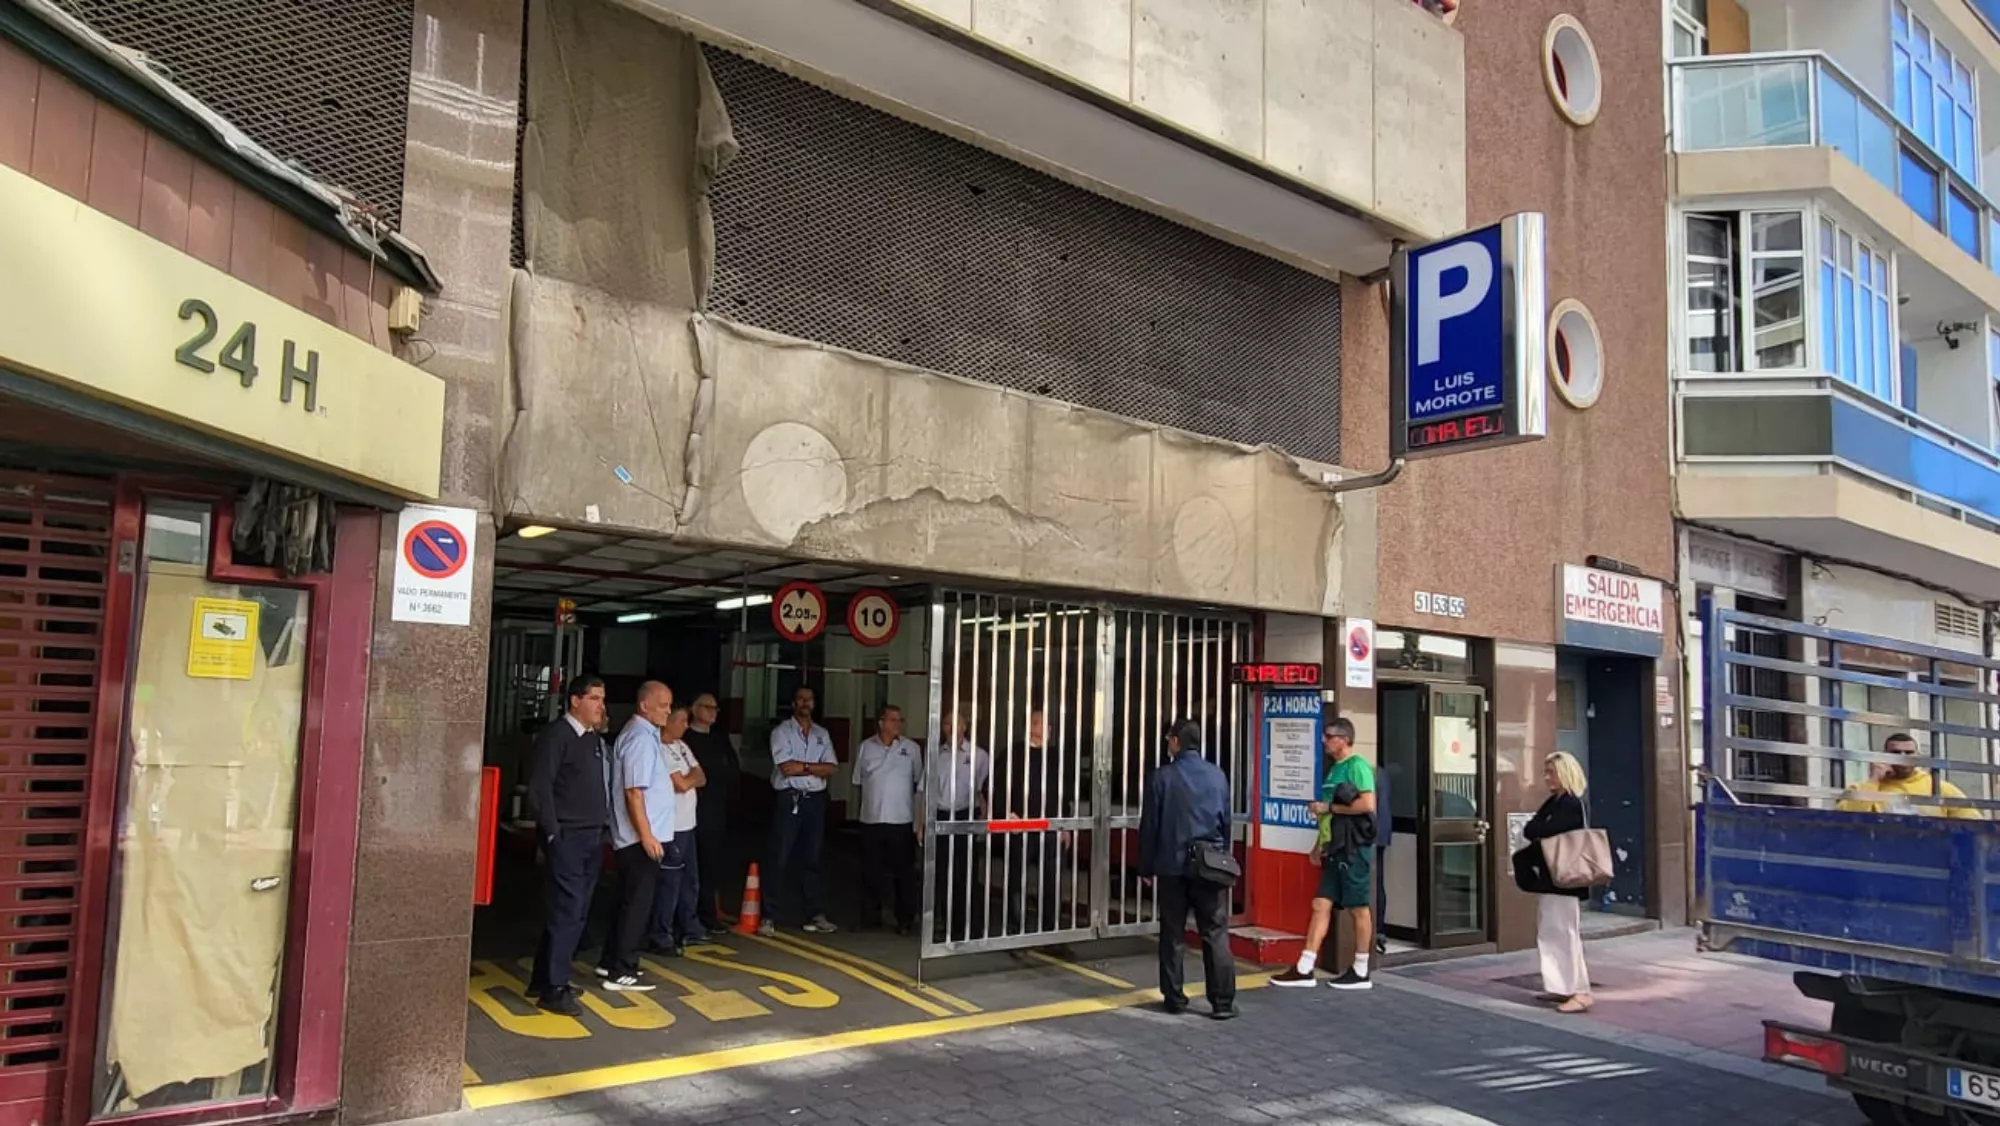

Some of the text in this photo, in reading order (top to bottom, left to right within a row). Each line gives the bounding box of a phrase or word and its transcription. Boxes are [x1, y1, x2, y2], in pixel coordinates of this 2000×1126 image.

[1417, 240, 1494, 366] P
[175, 298, 319, 413] 24 H
[1434, 371, 1475, 392] LUIS
[1415, 385, 1496, 414] MOROTE
[397, 586, 468, 600] VADO PERMANENTE
[1587, 572, 1640, 602] SALIDA
[1416, 594, 1464, 615] 51 53 55
[1566, 593, 1660, 629] EMERGENCIA
[861, 607, 886, 627] 10
[1285, 695, 1321, 714] HORAS
[1264, 801, 1279, 822] NO
[1851, 1055, 1908, 1078] IVECO
